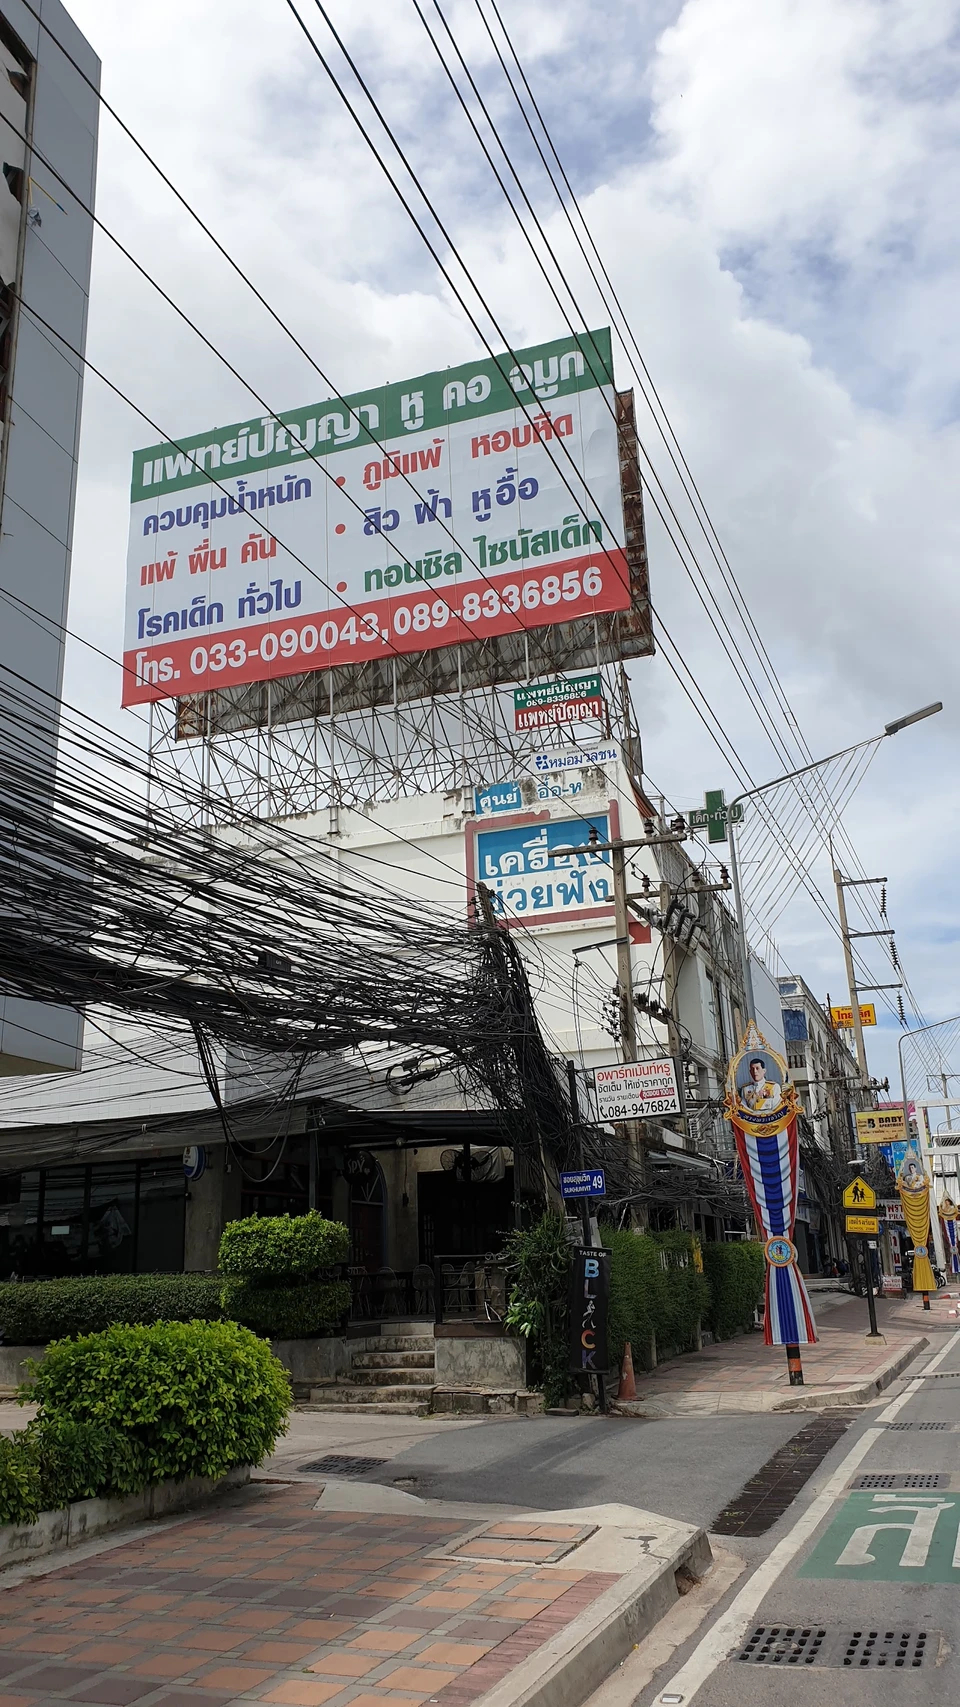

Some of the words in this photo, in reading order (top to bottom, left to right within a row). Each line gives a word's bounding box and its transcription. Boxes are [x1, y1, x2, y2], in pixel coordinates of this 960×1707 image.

[142, 403, 380, 487] แพทย์ปัญญา
[401, 391, 424, 430] หู
[443, 375, 491, 411] คอ
[508, 351, 585, 399] จมูก
[143, 475, 313, 536] ควบคุมน้ำหนัก
[363, 438, 445, 491] ภูมิแพ้
[471, 411, 573, 458] หอบหืด
[141, 550, 178, 586] แพ้
[188, 538, 227, 575] ผื่น
[241, 533, 277, 564] คัน
[363, 506, 400, 536] สิว
[414, 488, 453, 525] ฝ้า
[137, 595, 224, 640] โรคเด็ก
[238, 579, 302, 619] ทั่วไป
[364, 549, 462, 593] ทอนซิล
[472, 513, 603, 569] ไซนัสเด็ก
[135, 651, 181, 687] โทร.
[516, 679, 598, 701] แพทย์ปัญญา
[518, 701, 599, 728] แพทย์ปัญญา
[480, 786, 518, 809] ศนย์
[714, 806, 738, 821] ทั่วป
[608, 1098, 677, 1118] 084-9476824
[592, 1175, 603, 1189] 49
